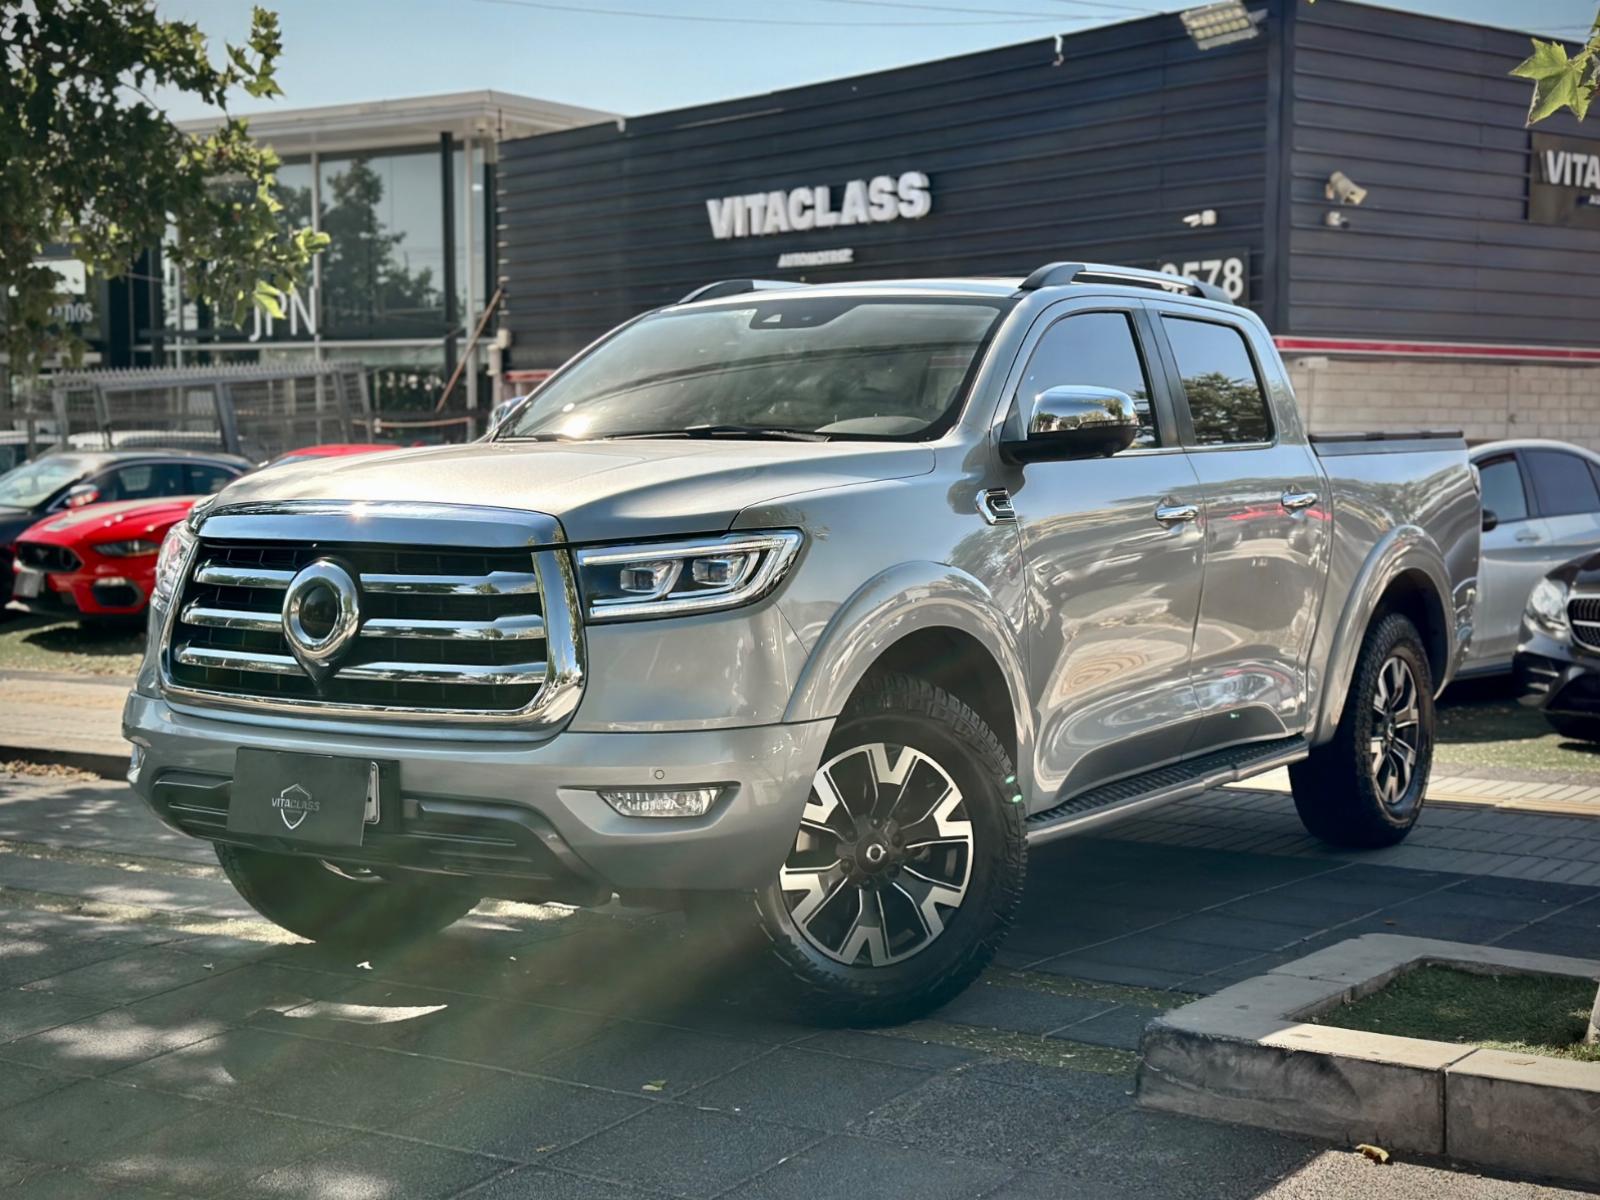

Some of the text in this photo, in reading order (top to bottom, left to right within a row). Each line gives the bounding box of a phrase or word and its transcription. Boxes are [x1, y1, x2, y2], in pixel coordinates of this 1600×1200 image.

[1546, 150, 1600, 189] VITA
[706, 171, 931, 239] VITACLASS
[271, 797, 320, 812] VITACLASS
